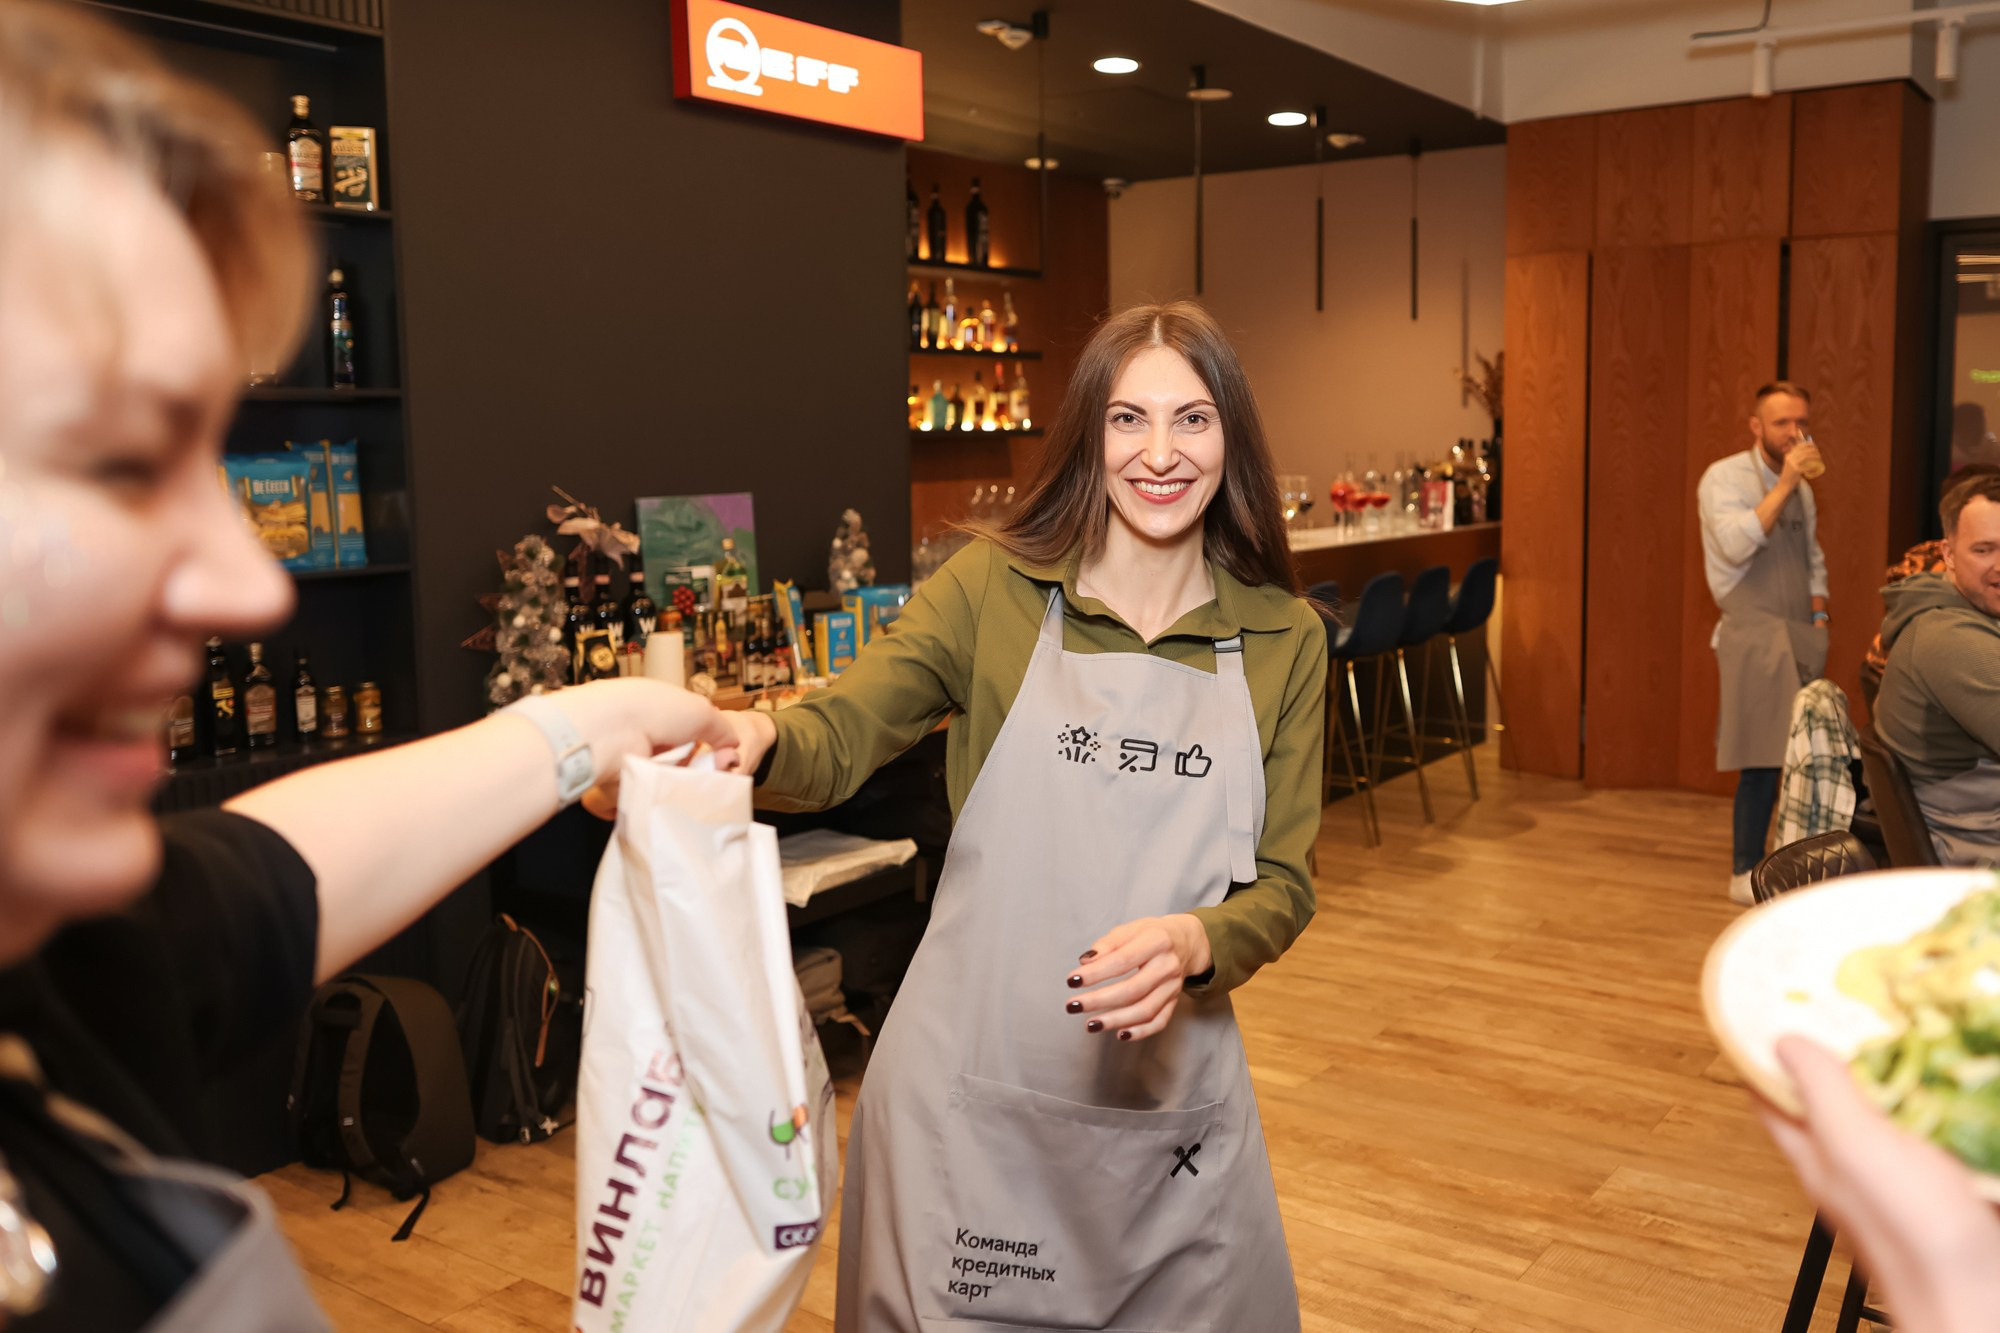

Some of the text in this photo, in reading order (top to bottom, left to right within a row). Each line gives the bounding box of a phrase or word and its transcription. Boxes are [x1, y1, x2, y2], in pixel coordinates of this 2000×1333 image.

[609, 1105, 706, 1333] МАРКЕТ НАПТ
[955, 1227, 1039, 1257] Команда
[951, 1256, 1057, 1282] кредитных
[947, 1280, 992, 1303] карт
